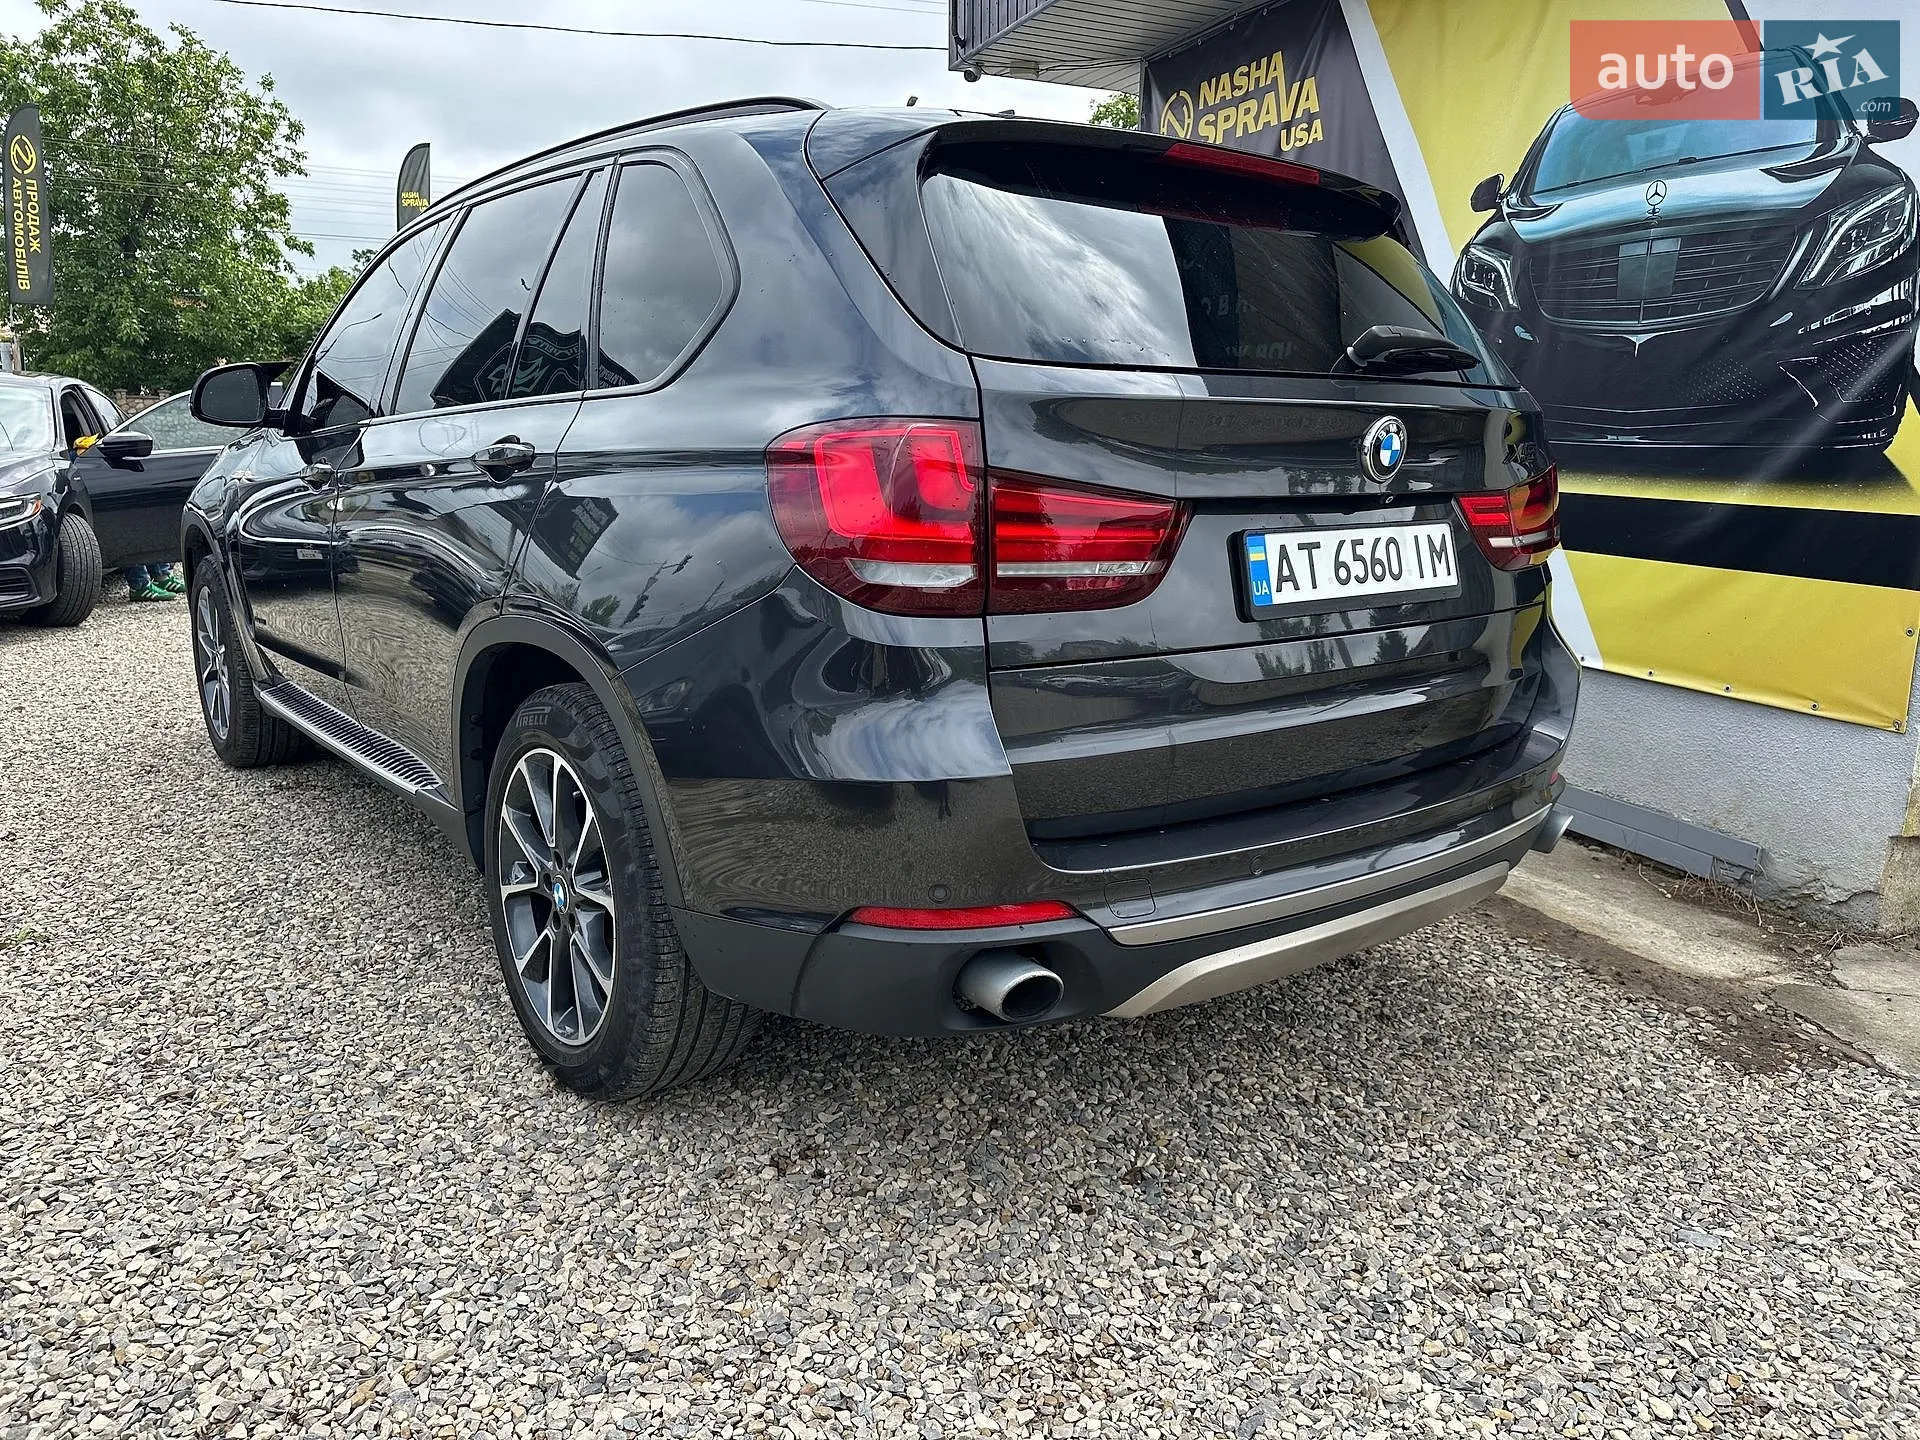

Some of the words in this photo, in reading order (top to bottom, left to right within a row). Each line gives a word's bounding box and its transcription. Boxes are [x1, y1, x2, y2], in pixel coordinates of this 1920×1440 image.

[1197, 76, 1320, 144] SPRAVA
[1198, 50, 1283, 110] NASHA
[1280, 118, 1323, 152] USA
[25, 178, 41, 254] ПРОДАЖ
[401, 198, 429, 207] SPRAVA
[12, 176, 31, 291] АВТОМОБІЛІВ
[1252, 580, 1270, 596] UA
[1275, 541, 1321, 593] AT
[1333, 536, 1403, 586] 6560
[1413, 533, 1452, 579] IM
[515, 706, 551, 728] PIRELLI
